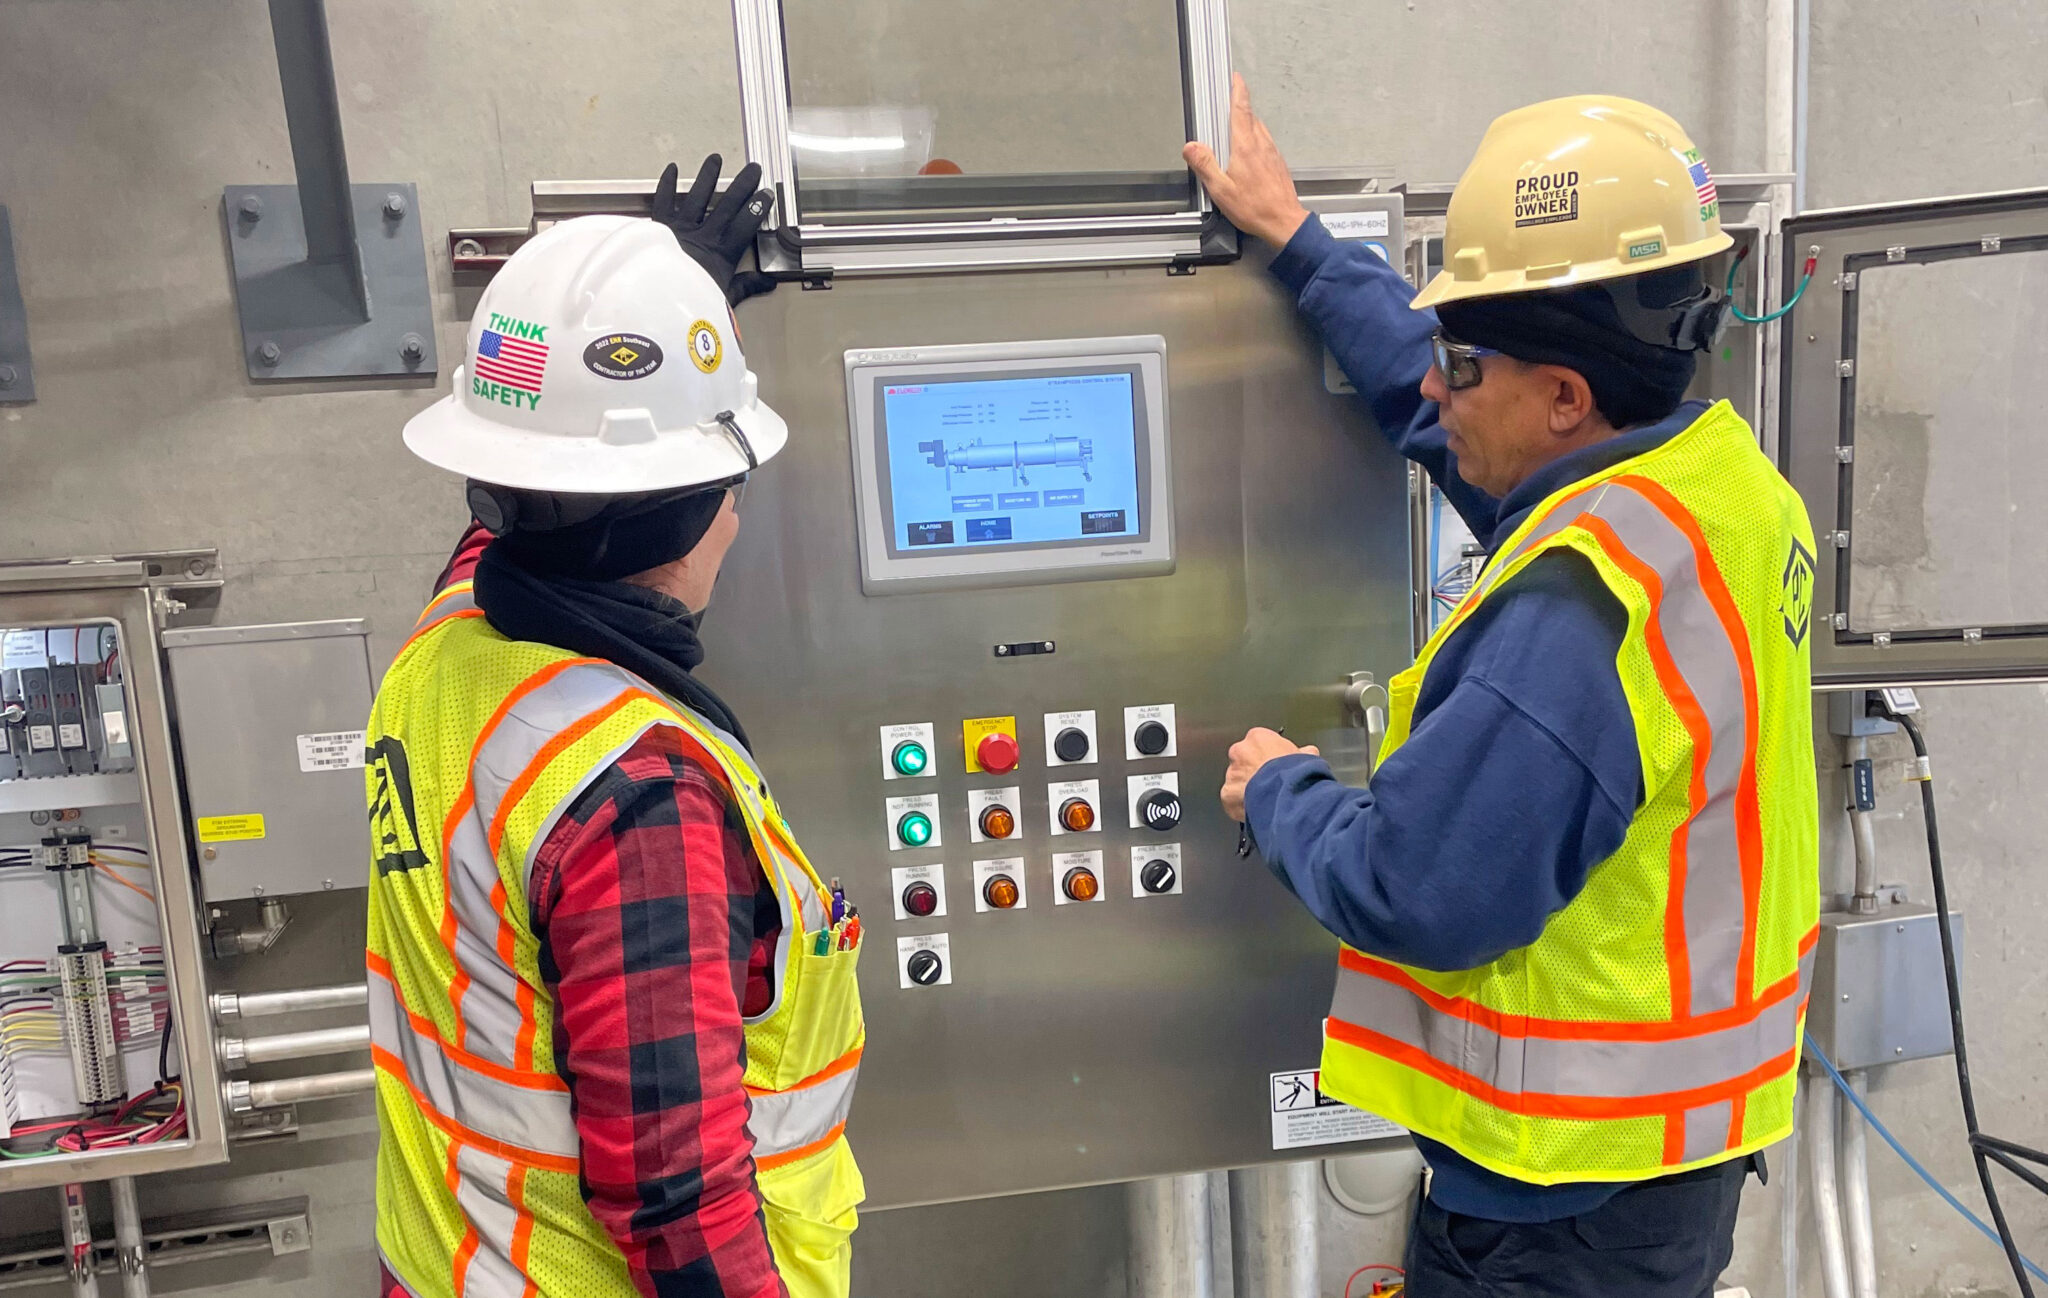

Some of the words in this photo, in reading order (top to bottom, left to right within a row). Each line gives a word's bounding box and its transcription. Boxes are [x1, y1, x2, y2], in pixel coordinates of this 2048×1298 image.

[1516, 171, 1579, 195] PROUD
[1515, 188, 1568, 204] EMPLOYEE
[1515, 198, 1568, 217] OWNER
[1700, 201, 1719, 222] SAF
[1631, 244, 1659, 256] MSA
[489, 312, 549, 342] THINK
[595, 339, 609, 350] 2022
[702, 333, 710, 352] 8
[593, 362, 627, 378] CONTRACTOR
[473, 377, 542, 411] SAFETY
[1088, 511, 1119, 519] SETPOINTS
[919, 523, 942, 531] ALARMS
[972, 718, 1006, 726] EMERGENCY
[1058, 787, 1089, 795] OVERLOAD
[907, 801, 933, 809] RUNNING
[984, 864, 1014, 872] PRESSURE
[1288, 1112, 1317, 1120] EQUIPMENT
